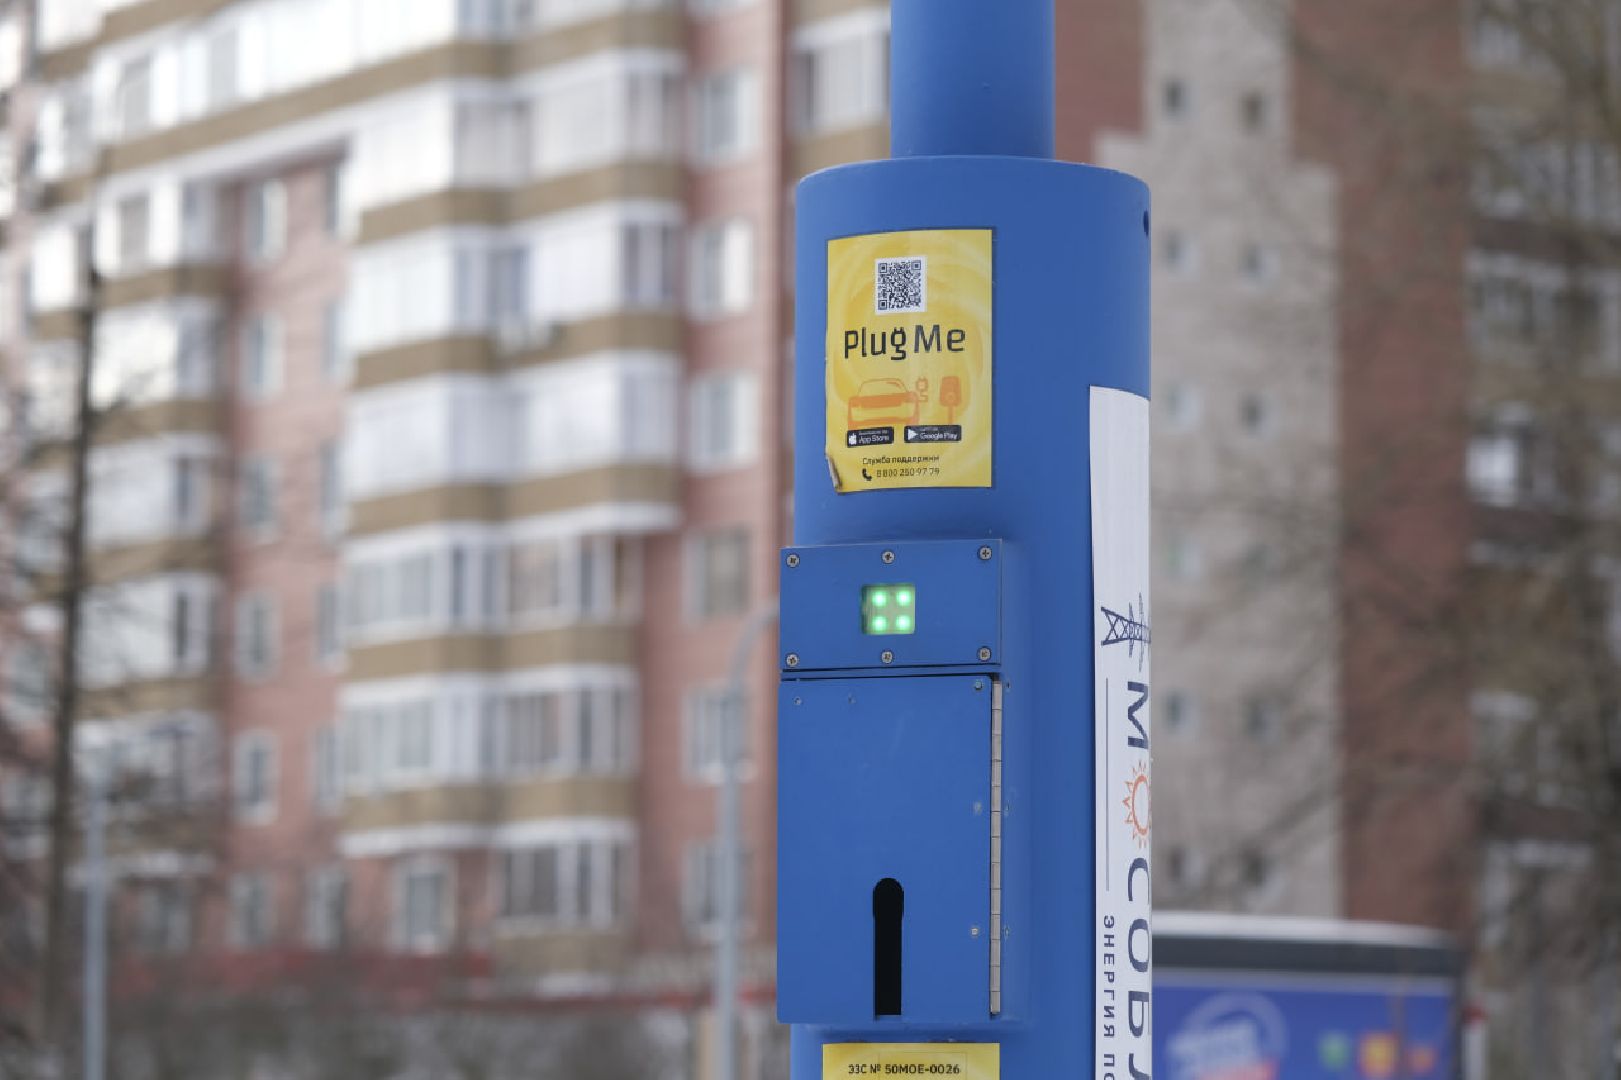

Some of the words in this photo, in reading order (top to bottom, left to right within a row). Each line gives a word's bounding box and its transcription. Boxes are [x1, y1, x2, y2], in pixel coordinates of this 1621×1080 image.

[858, 436, 871, 444] App
[872, 434, 890, 442] Store
[919, 432, 943, 440] Google
[943, 432, 958, 440] Play
[862, 455, 891, 466] Служба
[892, 456, 940, 464] поддержки
[1103, 915, 1115, 1039] ЭНЕРГИЯ
